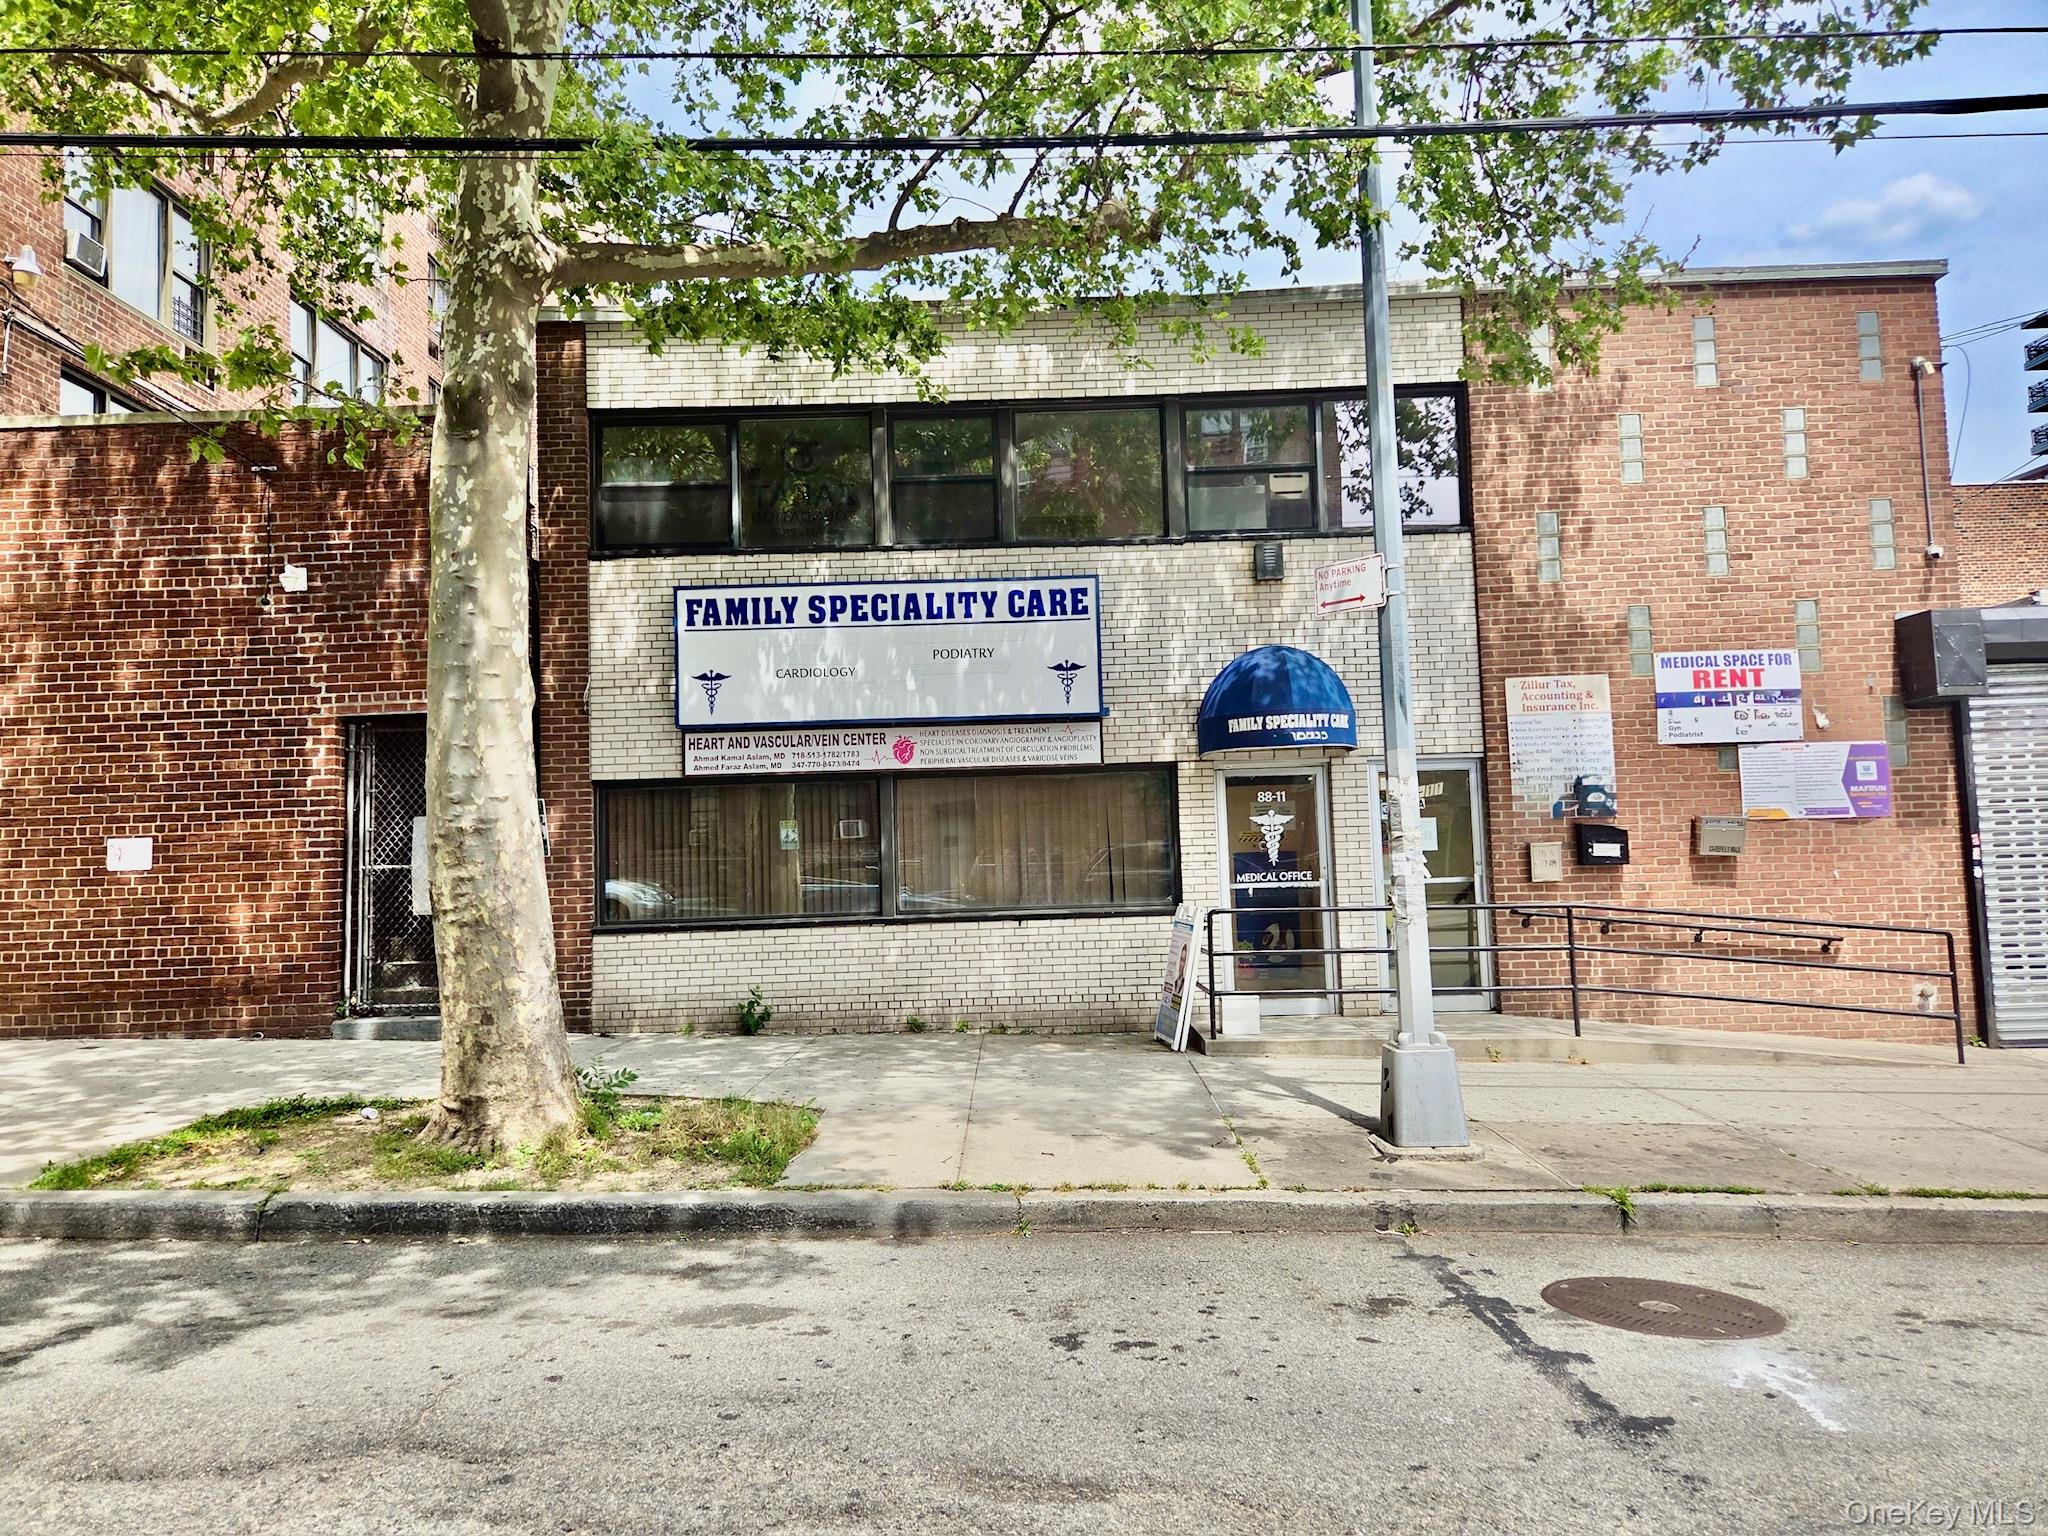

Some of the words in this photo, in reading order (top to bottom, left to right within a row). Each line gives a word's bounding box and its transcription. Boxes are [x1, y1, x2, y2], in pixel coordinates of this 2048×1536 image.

[1318, 570, 1329, 580] NO
[1331, 563, 1367, 578] PARKING
[1319, 579, 1352, 592] Anytime
[685, 596, 798, 627] FAMILY
[808, 590, 998, 624] SPECIALITY
[1007, 587, 1089, 618] CARE
[932, 648, 995, 660] PODIATRY
[1660, 655, 1720, 669] MEDICAL
[1723, 653, 1765, 667] SPACE
[1768, 652, 1792, 666] FOR
[775, 667, 856, 679] CARDIOLOGY
[1692, 668, 1765, 689] RENT
[1520, 680, 1551, 690] Zillur
[1553, 679, 1576, 689] Tax,
[1521, 690, 1583, 701] Accounting
[1585, 690, 1594, 699] &
[1522, 703, 1576, 712] Insurance
[1579, 702, 1599, 710] Inc.
[1227, 716, 1264, 733] FAMILY
[1265, 713, 1330, 730] SPECIALITY
[1014, 727, 1050, 735] TREATMENT
[688, 737, 725, 750] HEART
[727, 736, 750, 749] AND
[754, 734, 841, 748] VASCULAR/VEIN
[843, 732, 887, 746] CENTER
[920, 738, 955, 746] SPECIALIST
[964, 737, 1000, 745] CORONARY
[1000, 735, 1046, 744] ANGIOGRAPHY
[920, 747, 934, 755] NON
[935, 746, 966, 755] SURGICAL
[968, 746, 1004, 754] TREATMENT
[1005, 745, 1014, 753] OF
[1016, 745, 1059, 753] CIRCULATION
[1059, 744, 1095, 752] PROBLEMS,
[693, 754, 719, 762] Ahmad
[721, 753, 745, 761] Kamal
[746, 753, 772, 761] Aslam,
[773, 752, 786, 760] MD
[920, 756, 956, 764] PERIPHERAL
[1027, 754, 1059, 762] VARICOSE
[1059, 753, 1078, 761] VEINS
[693, 763, 719, 772] Ahmed
[721, 763, 742, 771] Faraz
[743, 762, 769, 771] Aslam,
[770, 761, 782, 769] MD
[1257, 790, 1286, 802] 88-11
[1236, 871, 1278, 883] MEDICAL
[1279, 870, 1313, 881] OFFICE
